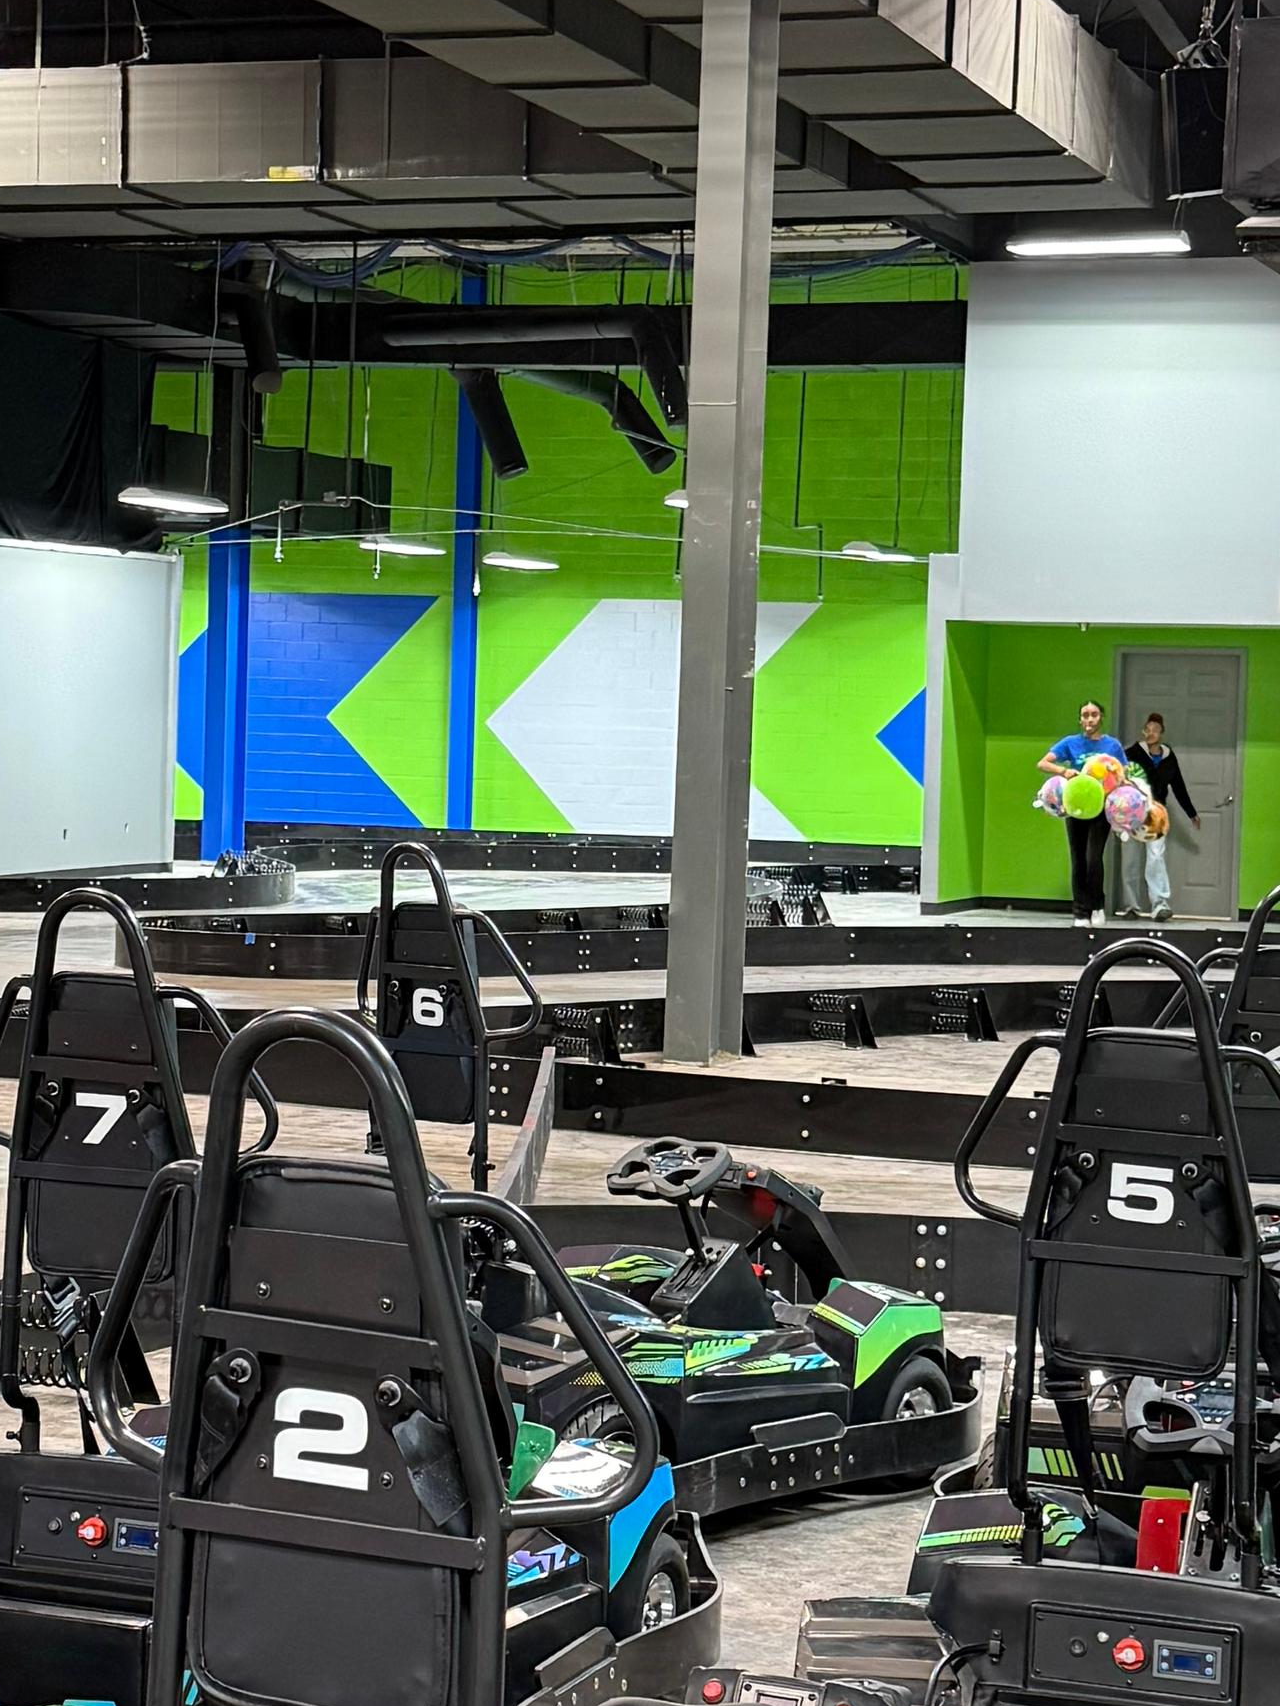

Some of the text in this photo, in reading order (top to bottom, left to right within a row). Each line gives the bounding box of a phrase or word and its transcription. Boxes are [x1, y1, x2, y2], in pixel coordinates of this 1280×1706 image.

[413, 988, 443, 1026] 6
[76, 1093, 127, 1144] 7
[1108, 1163, 1174, 1223] 5
[273, 1388, 368, 1490] 2
